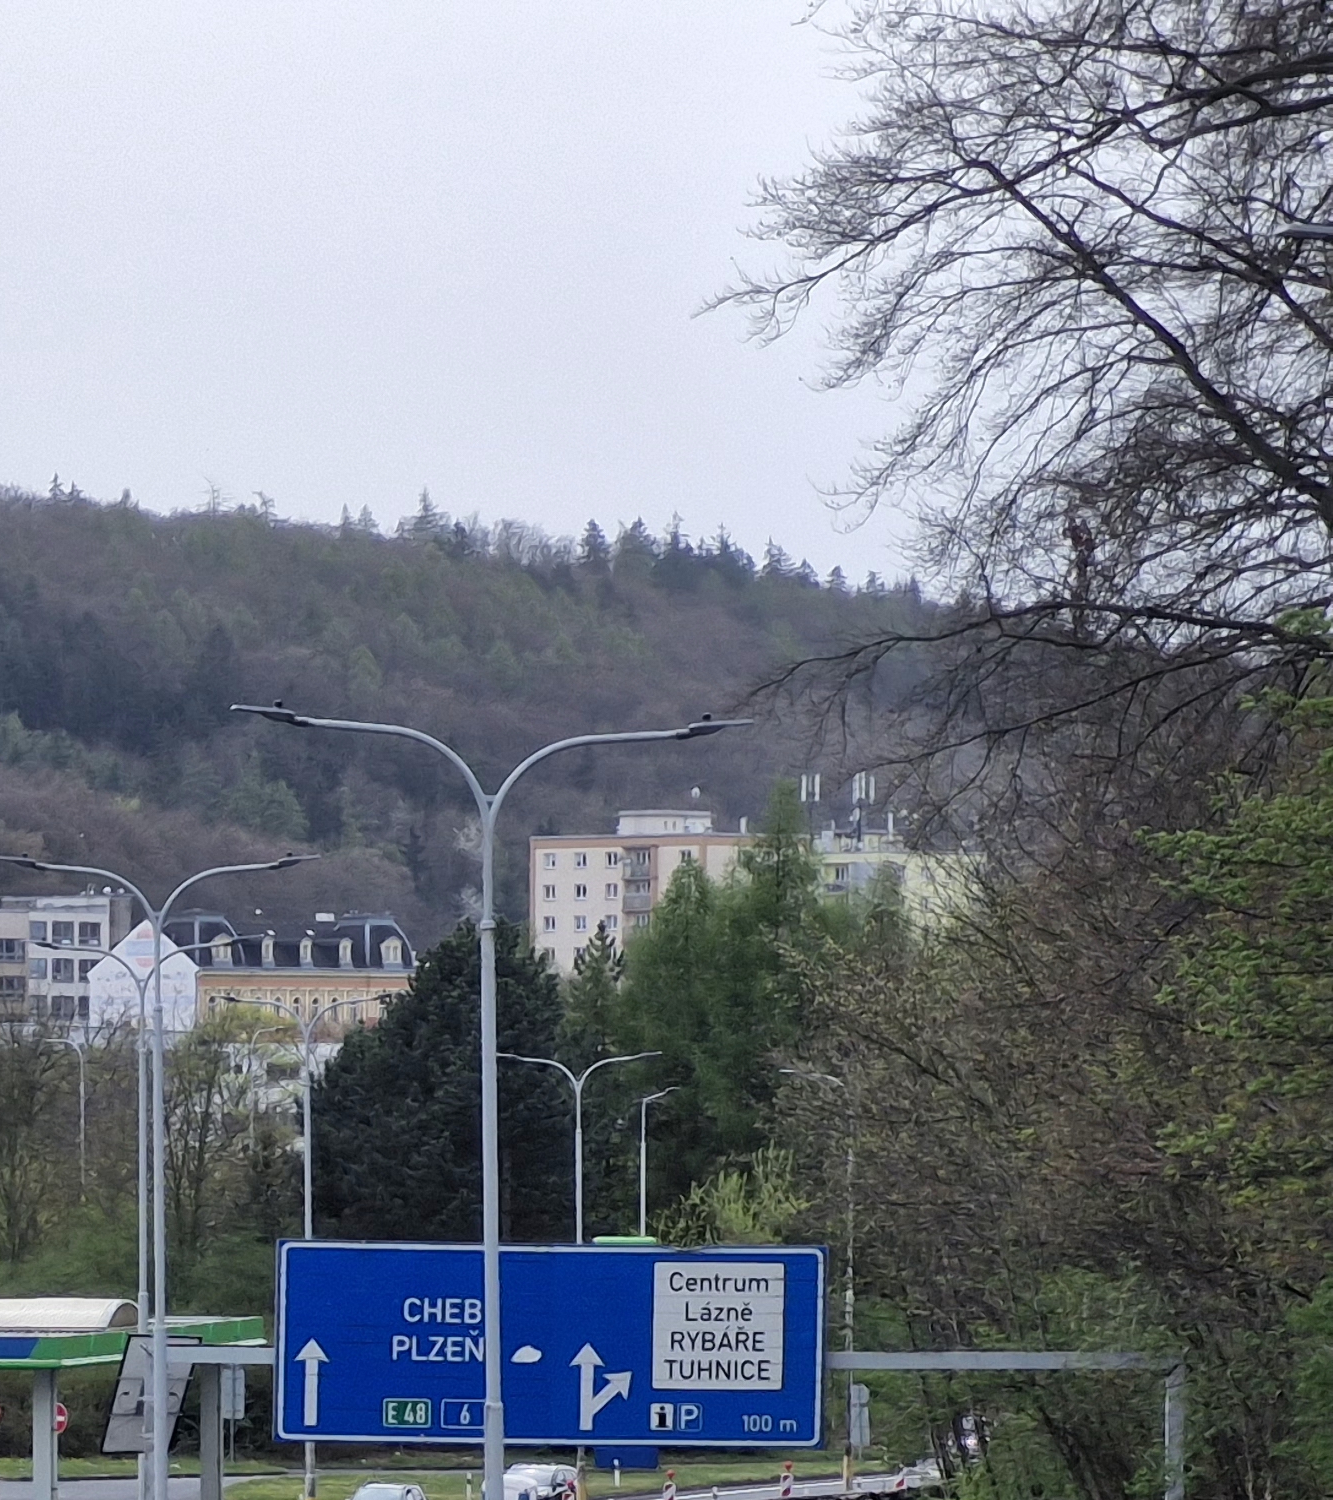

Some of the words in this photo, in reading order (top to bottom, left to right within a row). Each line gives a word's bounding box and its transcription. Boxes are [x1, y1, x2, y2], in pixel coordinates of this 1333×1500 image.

[669, 1271, 769, 1293] Centrum
[403, 1297, 482, 1324] CHEB
[685, 1300, 753, 1322] Lázně
[392, 1329, 485, 1362] PLZEŇ
[670, 1325, 766, 1352] RYBÁŘE
[663, 1359, 771, 1381] TUHNICE
[387, 1402, 398, 1424] E
[403, 1402, 426, 1424] 48
[459, 1403, 470, 1425] 6
[680, 1405, 699, 1429] P
[741, 1414, 772, 1433] 100
[779, 1419, 797, 1433] m
